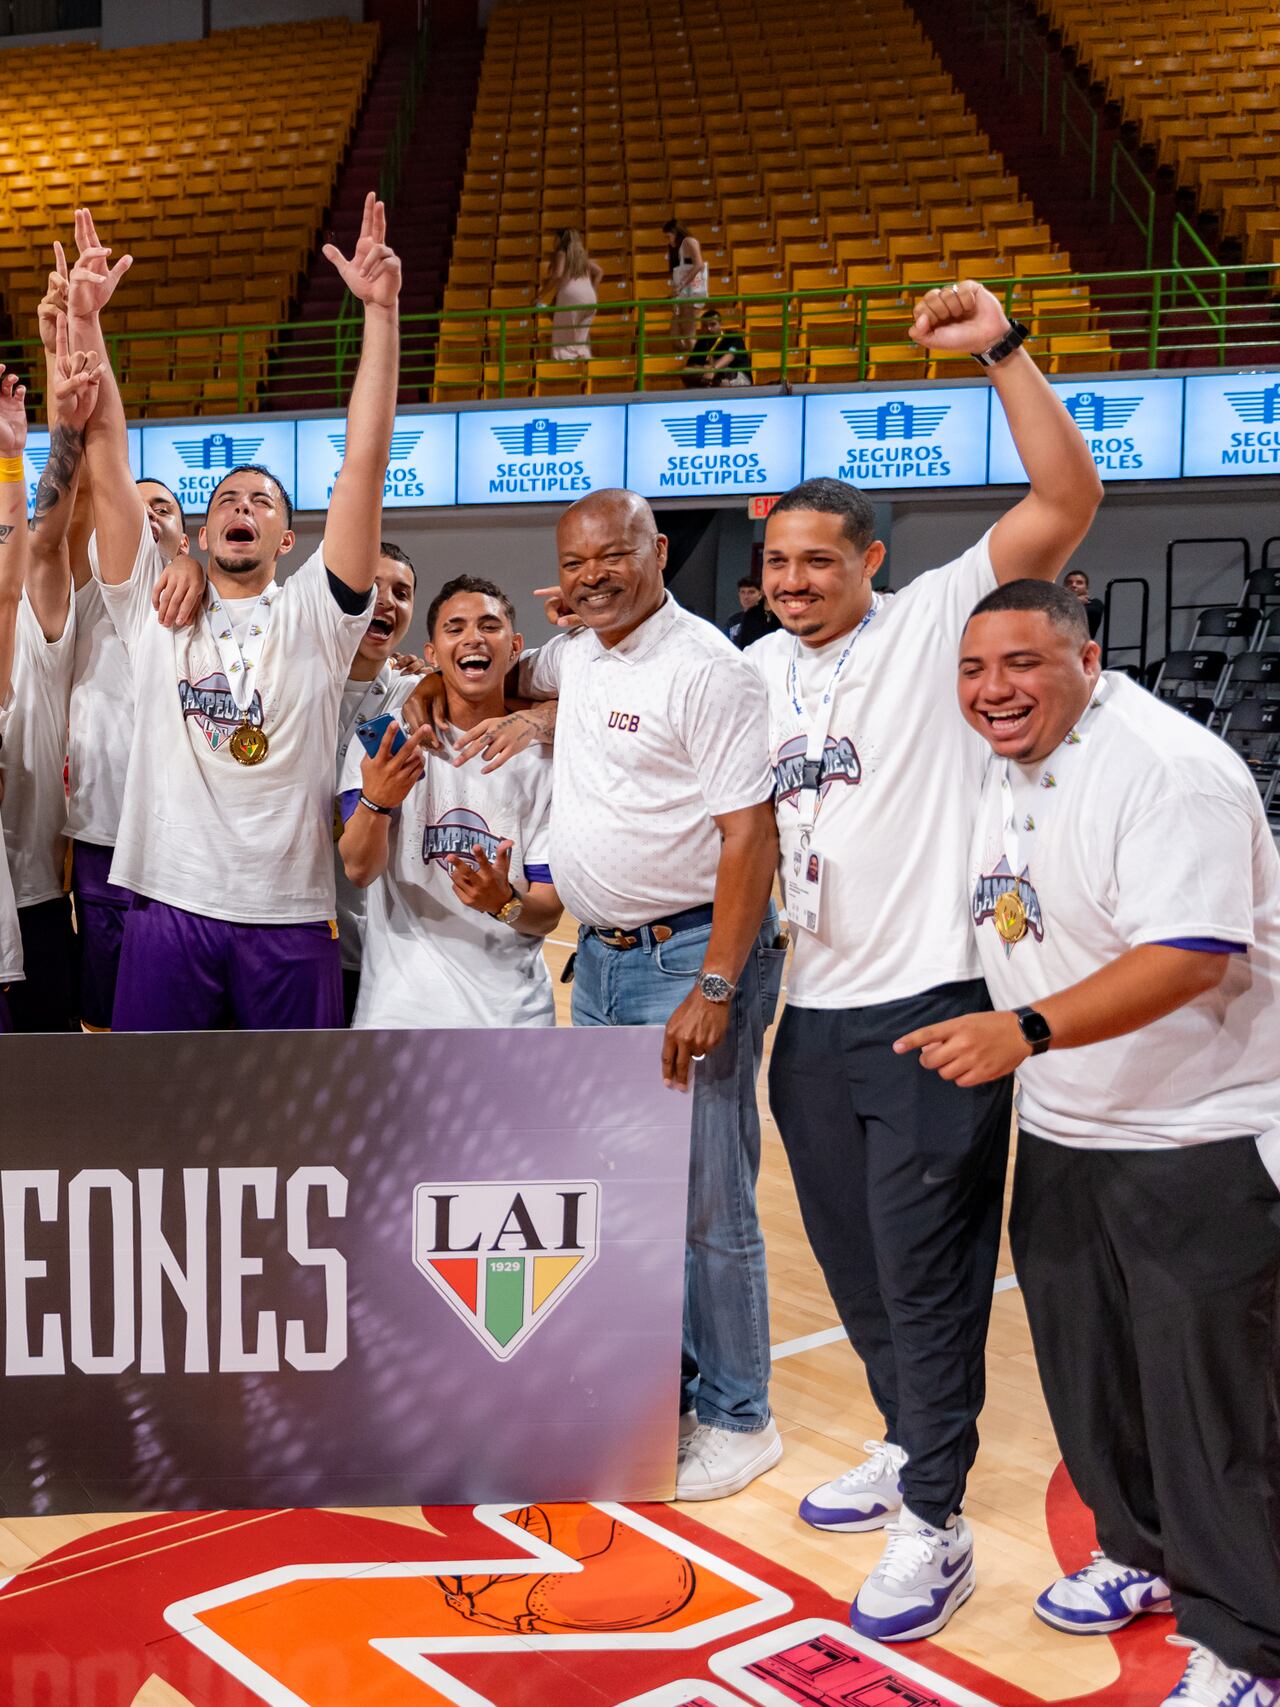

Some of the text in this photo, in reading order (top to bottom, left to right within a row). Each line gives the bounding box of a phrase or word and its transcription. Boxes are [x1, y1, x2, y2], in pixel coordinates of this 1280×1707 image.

[1231, 431, 1280, 447] SEGU
[667, 453, 760, 471] SEGUROS
[847, 446, 943, 463] SEGUROS
[496, 461, 585, 478] SEGUROS
[659, 468, 768, 486] MULTIPLES
[839, 461, 951, 479] MULTIPLES
[178, 476, 222, 490] SEGU
[489, 476, 592, 493] MULTIPLES
[608, 711, 640, 732] UCB
[427, 1192, 588, 1253] LAI
[490, 1262, 521, 1272] 1929
